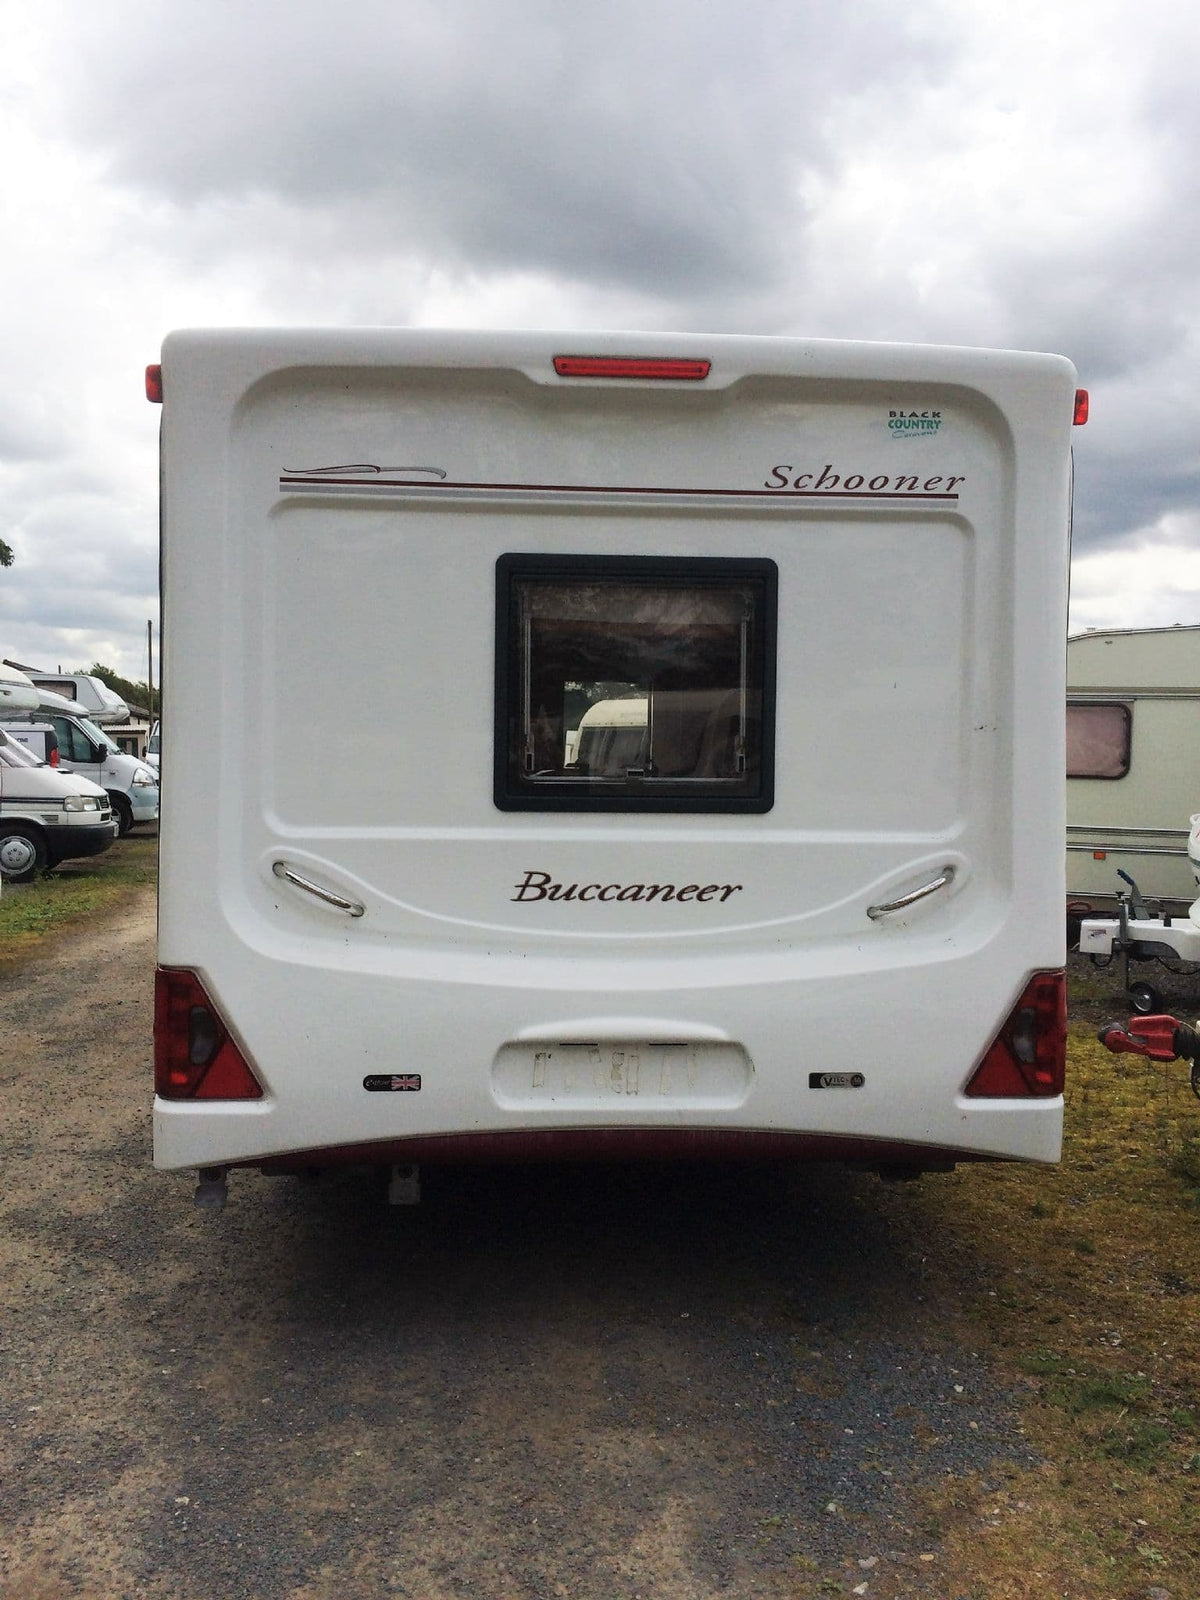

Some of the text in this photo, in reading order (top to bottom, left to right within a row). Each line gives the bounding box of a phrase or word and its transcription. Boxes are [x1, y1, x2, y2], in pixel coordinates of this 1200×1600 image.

[888, 419, 941, 429] COUNTRY
[764, 465, 965, 492] Schooner
[510, 871, 743, 902] Buccaneer
